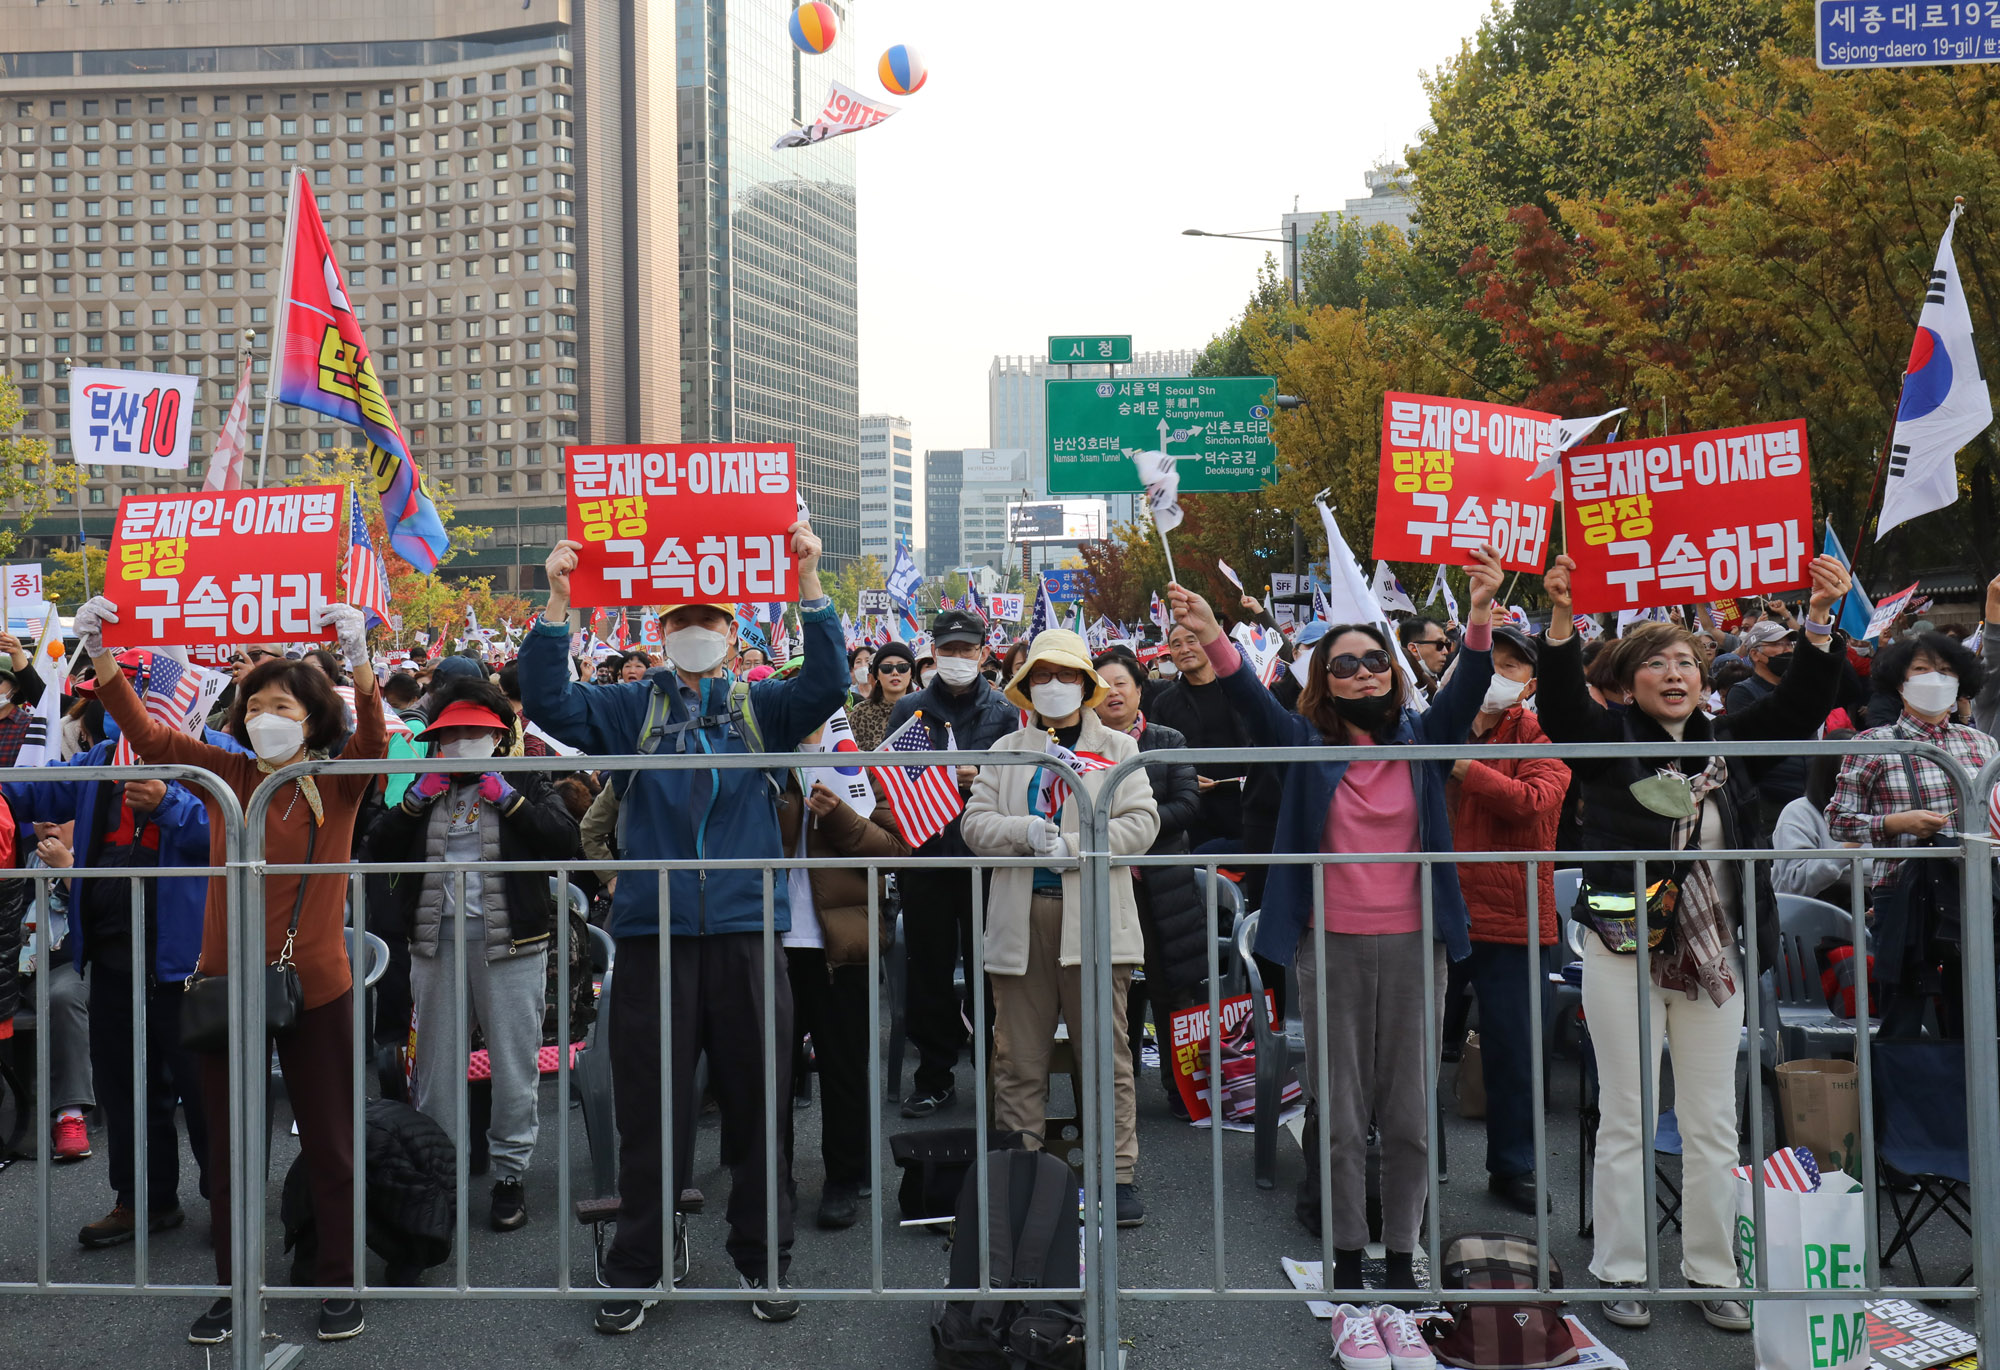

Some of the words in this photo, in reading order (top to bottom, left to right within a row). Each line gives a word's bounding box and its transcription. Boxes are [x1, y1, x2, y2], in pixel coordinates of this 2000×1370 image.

[1829, 40, 1927, 62] Sejong-daero
[1101, 385, 1111, 395] 21
[1118, 382, 1160, 396] 서울역
[1165, 386, 1194, 395] Seoul
[1198, 386, 1216, 395] Stn
[1118, 401, 1160, 416] 숭례문
[1165, 409, 1224, 419] Sungnyemun
[90, 387, 181, 458] 부산10
[1205, 420, 1271, 435] 신촌로터리
[1053, 436, 1120, 451] 남산3호터널
[1175, 431, 1187, 440] 60
[1205, 435, 1241, 446] Sinchon
[1243, 434, 1272, 446] Rotary
[1053, 453, 1078, 463] Namsan
[1101, 452, 1121, 462] Tunnel
[1204, 452, 1256, 465] 덕수궁길
[1570, 429, 1802, 501] 문재인·이재명
[573, 452, 790, 497] 문재인·이재명
[1205, 466, 1254, 476] Deoksugung
[1261, 465, 1271, 476] gil
[1392, 451, 1454, 493] 당장
[121, 493, 336, 540] 문재인·이재명
[578, 496, 648, 542] 당장
[1577, 494, 1653, 546] 당장
[1406, 493, 1546, 567] 구속하라
[120, 537, 188, 581] 당장
[603, 534, 791, 599] 구속하라
[1606, 520, 1804, 603] 구속하라
[136, 572, 328, 639] 구속하라
